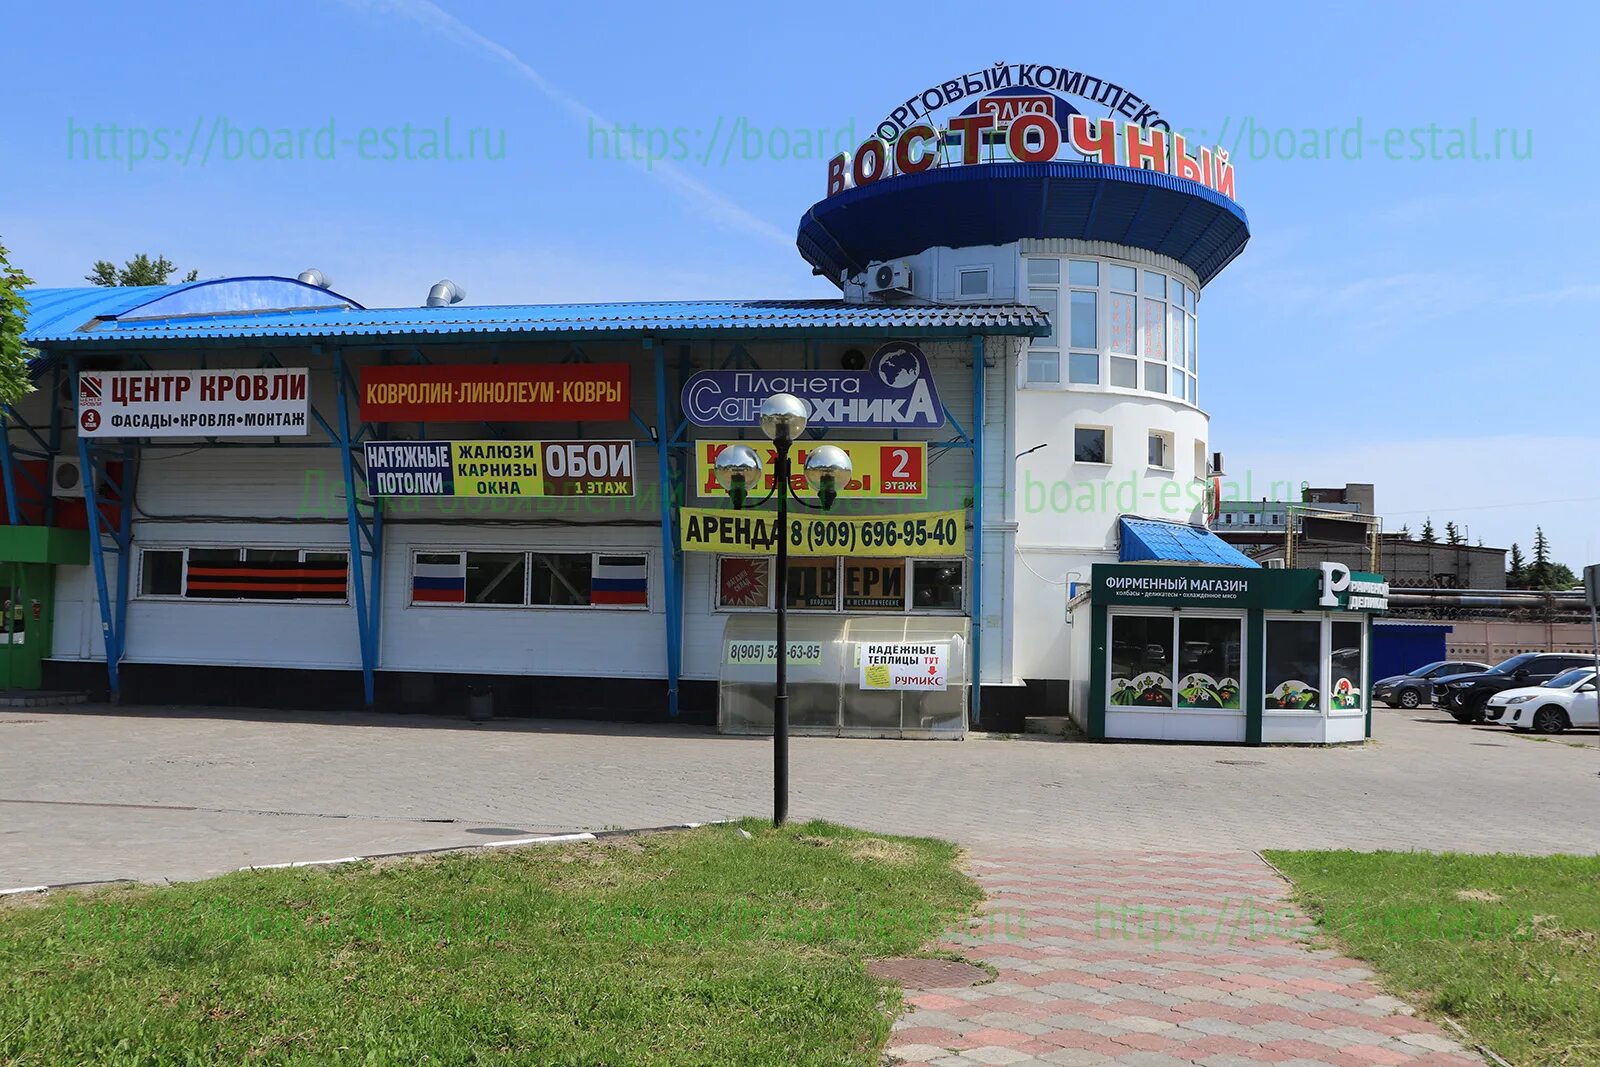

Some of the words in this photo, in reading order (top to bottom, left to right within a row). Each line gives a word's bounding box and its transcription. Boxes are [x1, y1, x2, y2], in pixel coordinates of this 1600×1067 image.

[871, 61, 1012, 142] ОРГОВЫЙ
[827, 113, 1236, 200] ВОСТОЧНЫЙ
[111, 375, 191, 407] ЦЕНТР
[200, 374, 306, 402] КРОВЛИ
[366, 382, 451, 404] КОВРОЛИН
[458, 381, 554, 403] ЛИНОЛЕУМ
[562, 381, 621, 402] КОВРЫ
[734, 373, 861, 393] Планета
[688, 378, 938, 424] СанхникА
[87, 412, 95, 422] 3
[111, 413, 172, 429] ФАСАДЫ
[181, 413, 236, 428] КРОВЛЯ
[244, 412, 305, 427] МОНТАЖ
[367, 446, 449, 468] НАТЯЖНЫЕ
[459, 445, 534, 459] ЖАЛЮЗИ
[545, 445, 631, 478] ОБОИ
[458, 464, 537, 477] КАРНИЗЫ
[891, 449, 910, 478] 2
[377, 472, 443, 494] ПОТОЛКИ
[477, 481, 520, 495] ОКНА
[575, 482, 583, 494] 1
[586, 482, 627, 494] ЭТАЖ
[885, 481, 917, 490] этаж
[686, 515, 780, 550] АРЕНДА
[791, 521, 803, 546] 8
[807, 521, 856, 552] (909)
[861, 519, 957, 547] 696-95-40
[786, 566, 901, 600] ДВЕРИ
[1106, 577, 1187, 590] ФИРМЕННЫЙ
[1190, 580, 1248, 591] МАГАЗИН
[731, 645, 764, 662] 8(905)
[767, 645, 820, 659] 52-63-85
[868, 656, 918, 666] ТЕПЛИЦЫ
[923, 656, 939, 664] ТУТ
[895, 676, 943, 686] РУМИКС
